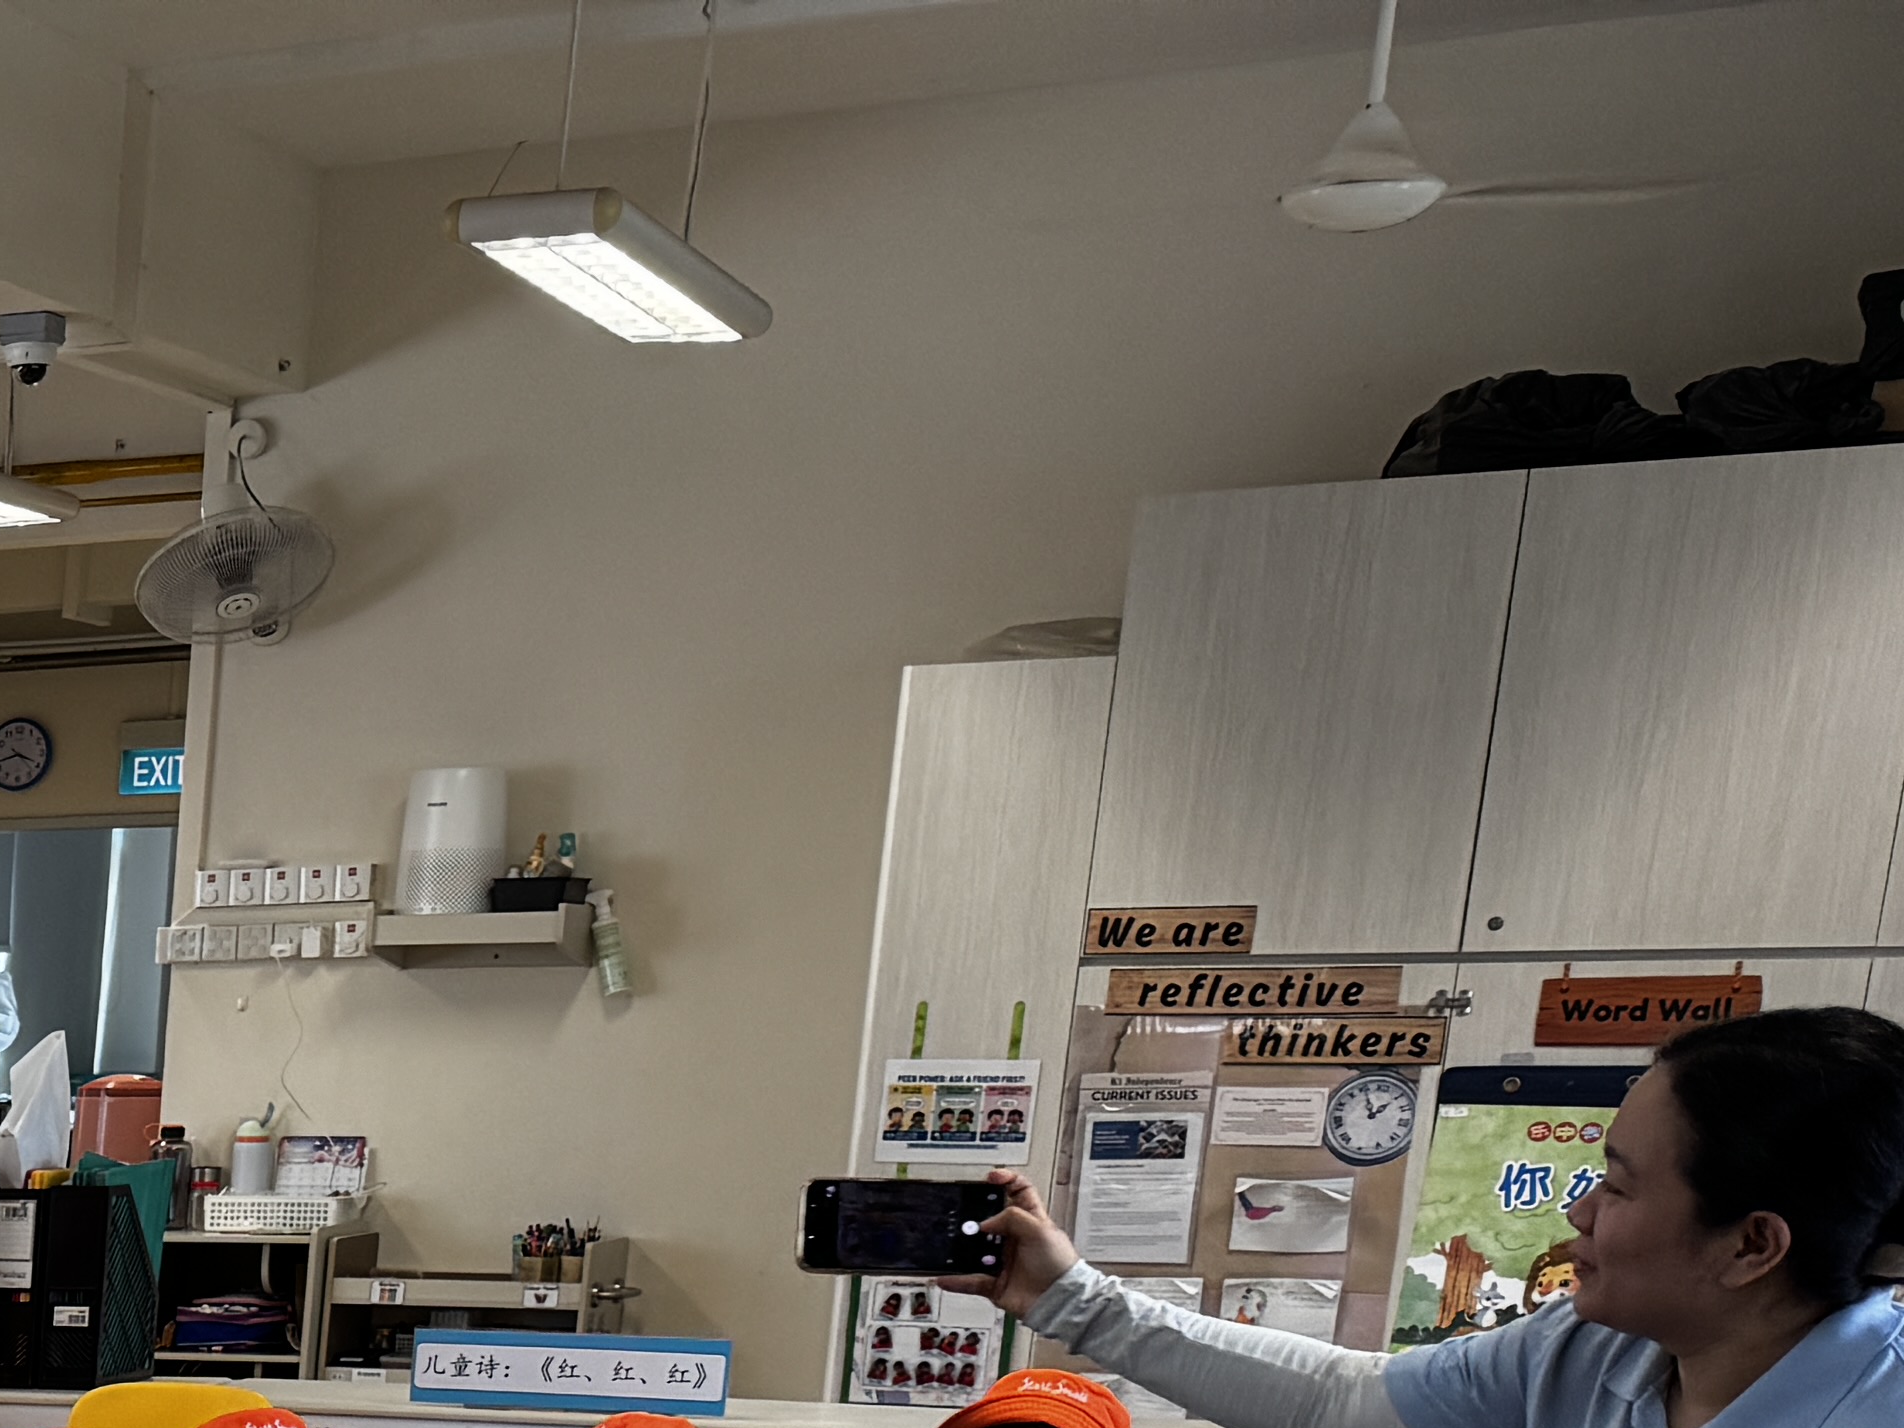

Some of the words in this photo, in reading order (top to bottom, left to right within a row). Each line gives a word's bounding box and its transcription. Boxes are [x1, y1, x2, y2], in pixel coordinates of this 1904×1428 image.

[133, 755, 185, 787] EXIT
[1097, 916, 1157, 948] We
[1171, 919, 1245, 948] are
[1137, 972, 1366, 1008] reflective
[1560, 997, 1649, 1023] Word
[1659, 997, 1733, 1022] Wall
[1237, 1023, 1432, 1058] thinkers
[1091, 1089, 1152, 1101] CURRENT
[1154, 1089, 1199, 1101] ISSUES
